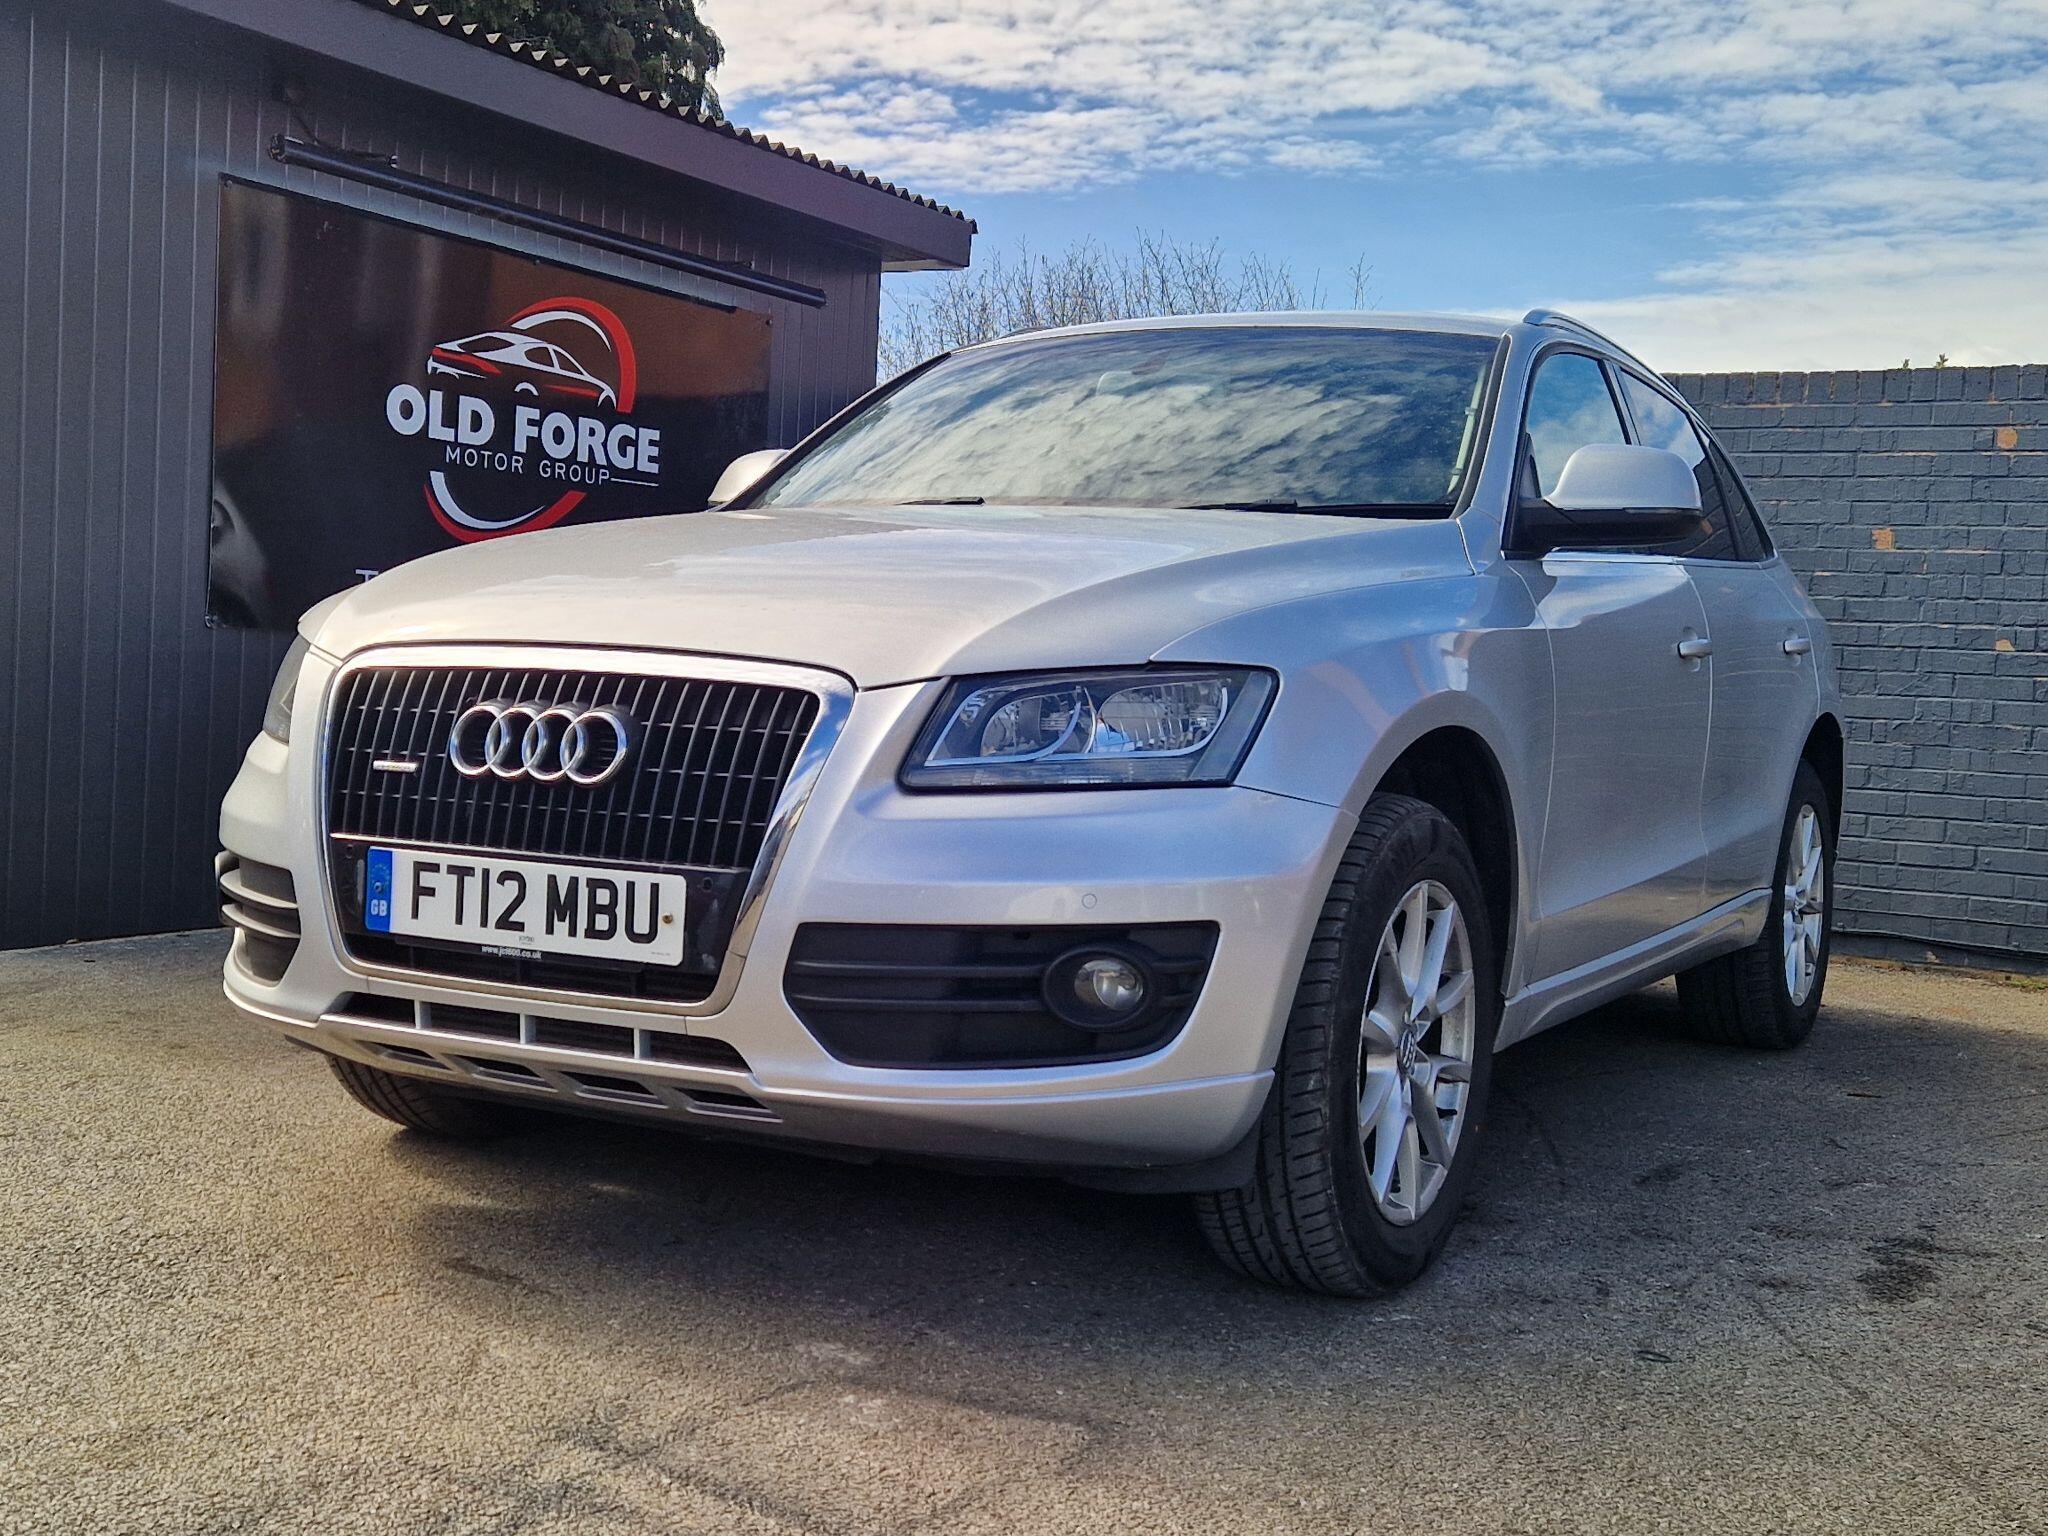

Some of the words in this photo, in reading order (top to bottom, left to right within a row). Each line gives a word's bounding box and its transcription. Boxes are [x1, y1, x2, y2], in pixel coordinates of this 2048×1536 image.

[386, 384, 495, 446] OLD
[514, 405, 660, 475] FORGE
[446, 446, 523, 474] MOTOR
[539, 460, 610, 486] GROUP
[371, 899, 388, 917] GB
[411, 860, 527, 932] FT12
[545, 873, 660, 945] MBU
